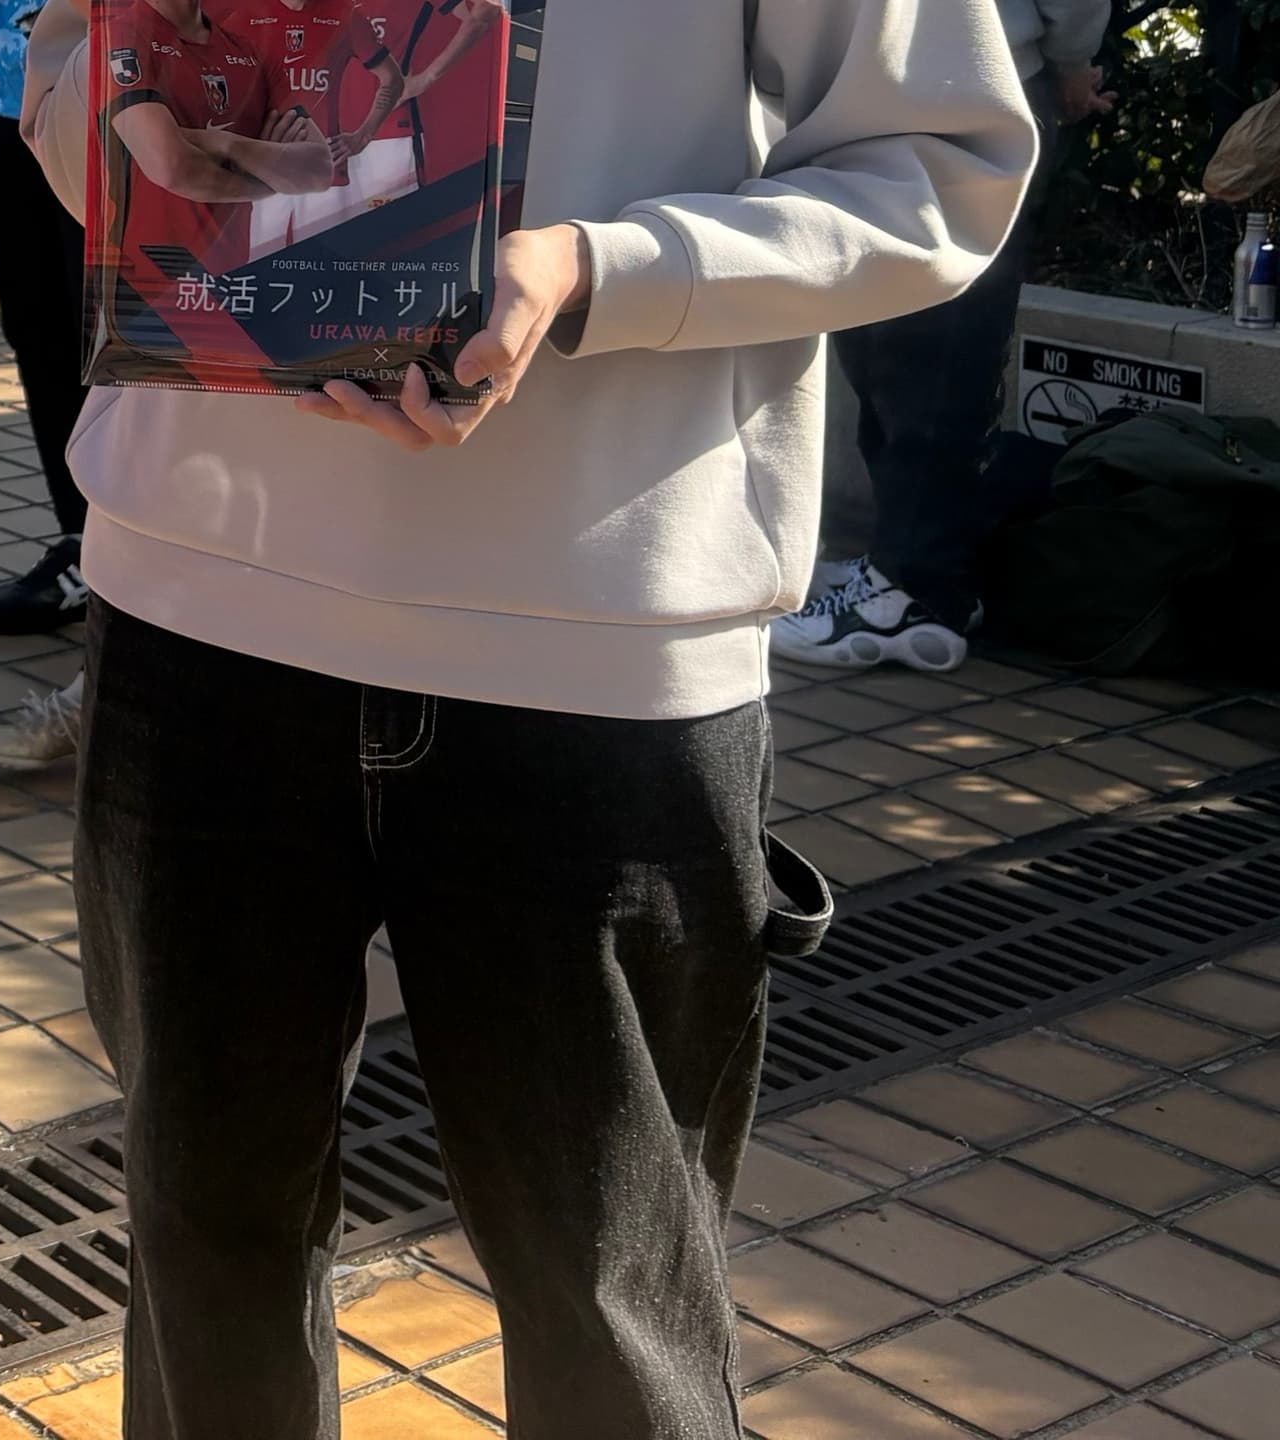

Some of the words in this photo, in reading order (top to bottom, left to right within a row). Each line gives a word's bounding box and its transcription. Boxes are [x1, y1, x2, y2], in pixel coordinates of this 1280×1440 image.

[286, 67, 330, 91] LUS
[272, 259, 326, 271] FOOTBALL
[332, 260, 386, 272] TOGETHER
[391, 261, 426, 272] URAWA
[431, 261, 460, 272] REDS
[175, 271, 468, 318] 就活フットサル
[309, 324, 387, 341] URAWA
[397, 326, 460, 344] REDS
[1043, 349, 1068, 373] NO
[1092, 358, 1182, 396] SMOKING
